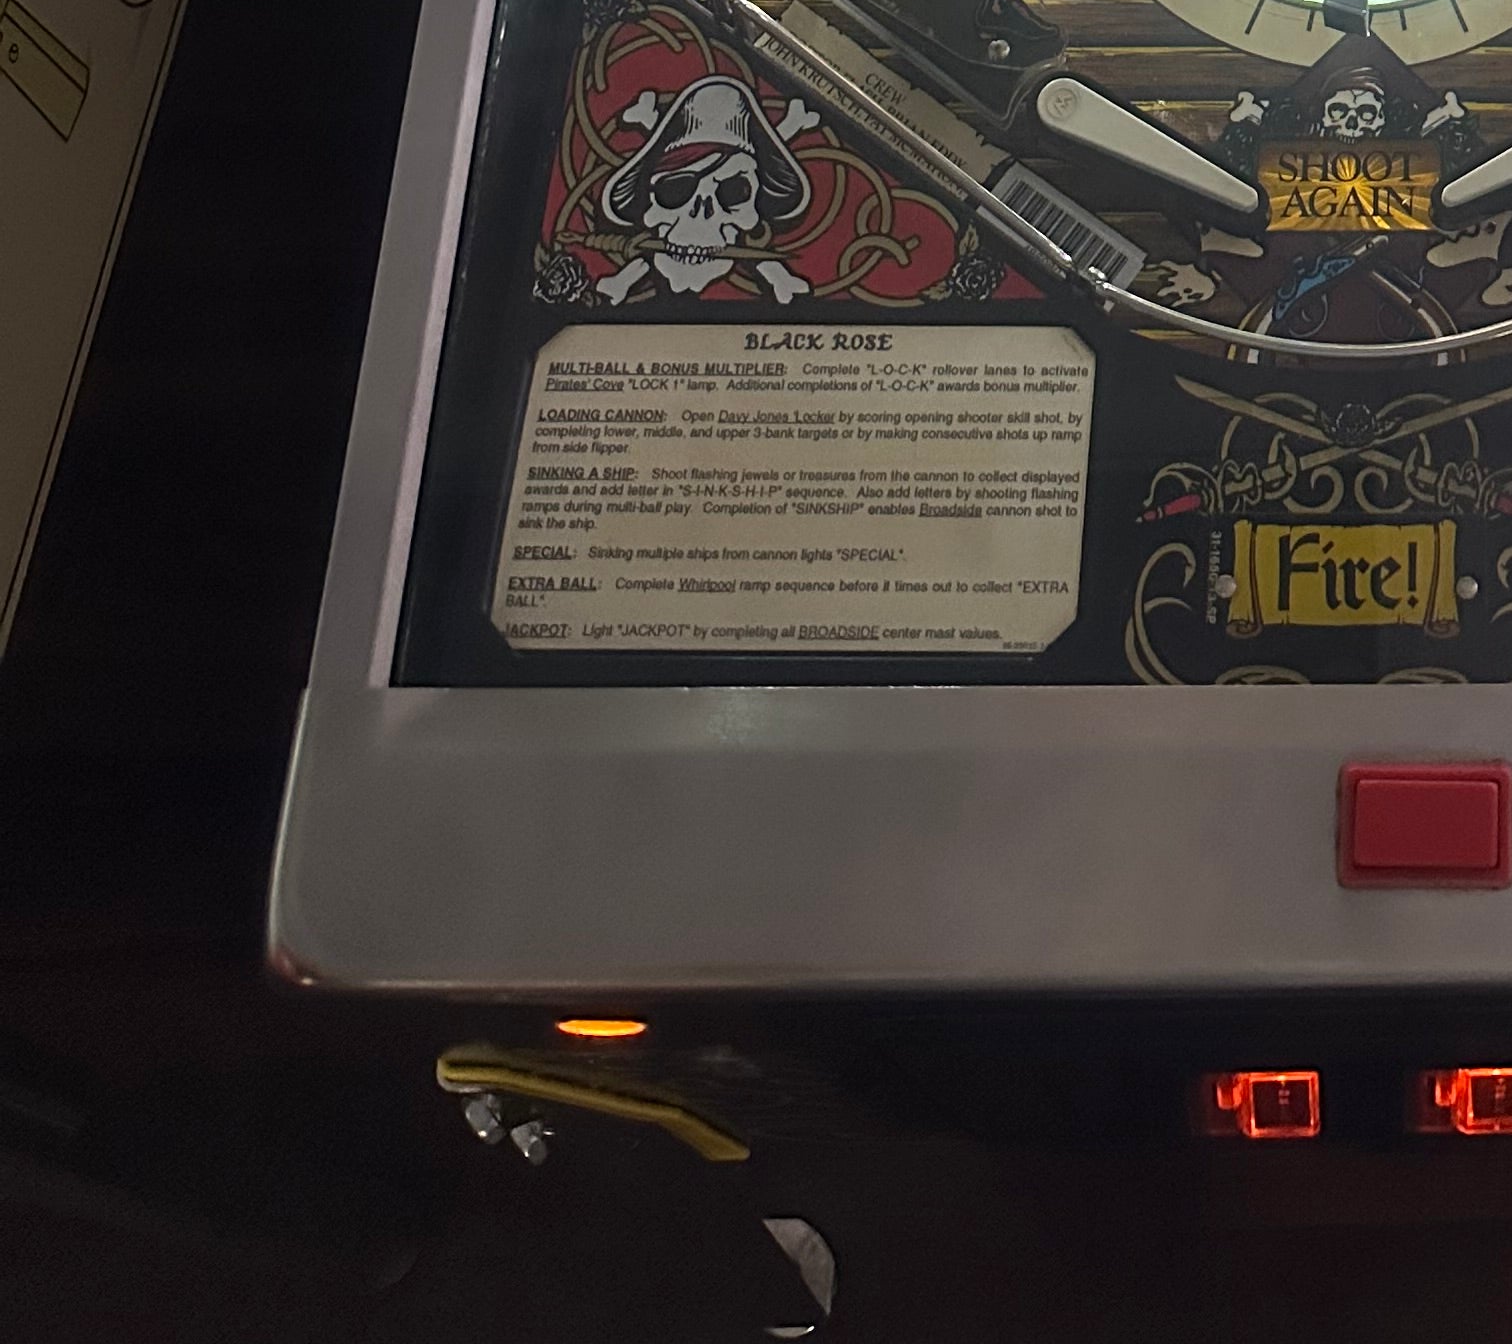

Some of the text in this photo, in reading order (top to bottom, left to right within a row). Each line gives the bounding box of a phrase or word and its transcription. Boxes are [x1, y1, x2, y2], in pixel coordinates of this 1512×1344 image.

[762, 35, 801, 72] JOHN
[864, 72, 907, 106] CREW
[1277, 150, 1420, 183] SHOOT
[1280, 185, 1415, 218] AGAIN
[744, 333, 895, 352] BLACK ROSE
[650, 363, 698, 375] BONUS
[704, 363, 788, 375] MULTIPLIER:
[802, 363, 860, 378] Complete
[932, 364, 977, 376] rollover
[984, 364, 1017, 376] lanes
[1022, 364, 1035, 376] to
[1041, 364, 1088, 376] activate
[592, 378, 624, 390] Cove
[726, 379, 784, 391] Additional
[787, 380, 857, 394] completions
[937, 381, 980, 392] awards
[982, 381, 1020, 392] bonus
[537, 410, 600, 421] LOADING
[680, 411, 714, 425] Open
[718, 411, 749, 425] Davy
[857, 412, 901, 426] scoring
[904, 412, 953, 426] opening
[957, 413, 1002, 423] shooter
[1006, 413, 1030, 424] skill
[534, 426, 601, 441] completing
[690, 427, 712, 439] and
[716, 429, 750, 442] upper
[796, 428, 838, 443] targets
[874, 428, 918, 443] making
[920, 429, 993, 440] consecutive
[996, 429, 1029, 441] shots
[1050, 431, 1082, 444] ramp
[531, 442, 588, 454] from side
[528, 468, 584, 479] SINKING
[652, 468, 686, 480] Shoot
[690, 469, 737, 483] flashing
[742, 469, 778, 484] jewels
[799, 469, 855, 481] treasures
[860, 469, 887, 481] from
[890, 470, 910, 482] the
[914, 472, 958, 482] cannon
[962, 470, 974, 482] to
[978, 470, 1017, 482] collect
[1021, 470, 1080, 486] displayed
[523, 485, 570, 496] awards
[571, 485, 596, 496] and
[599, 485, 624, 497] add
[626, 485, 659, 497] letter
[856, 487, 884, 498] Also
[886, 487, 911, 499] add
[913, 487, 952, 499] letters
[974, 488, 1028, 502] shooting
[1030, 488, 1080, 503] flashing
[521, 502, 560, 515] ramps
[562, 500, 602, 516] during
[701, 501, 772, 517] Completion
[867, 503, 916, 515] enables
[919, 503, 982, 516] Broadside
[985, 506, 1032, 516] cannon
[1034, 504, 1062, 517] shot
[1064, 504, 1078, 517] to
[517, 516, 566, 529] sink the
[588, 547, 633, 562] Sinking
[636, 547, 684, 562] multiple
[687, 547, 719, 562] ships
[722, 548, 750, 560] from
[752, 550, 798, 560] cannon
[800, 548, 833, 563] lights
[1277, 531, 1419, 612] Fire!
[507, 578, 556, 590] EXTRA
[614, 578, 674, 593] Complete
[678, 579, 736, 594] Whirlpool
[739, 581, 771, 594] ramp
[774, 581, 835, 595] sequence
[838, 579, 879, 592] before
[893, 580, 928, 592] times
[932, 580, 952, 593] out
[955, 580, 968, 593] to
[972, 580, 1012, 593] collect
[581, 624, 614, 641] Light
[710, 626, 779, 641] completing
[797, 627, 881, 639] BROADSIDE
[881, 627, 922, 639] center
[923, 628, 956, 640] mast
